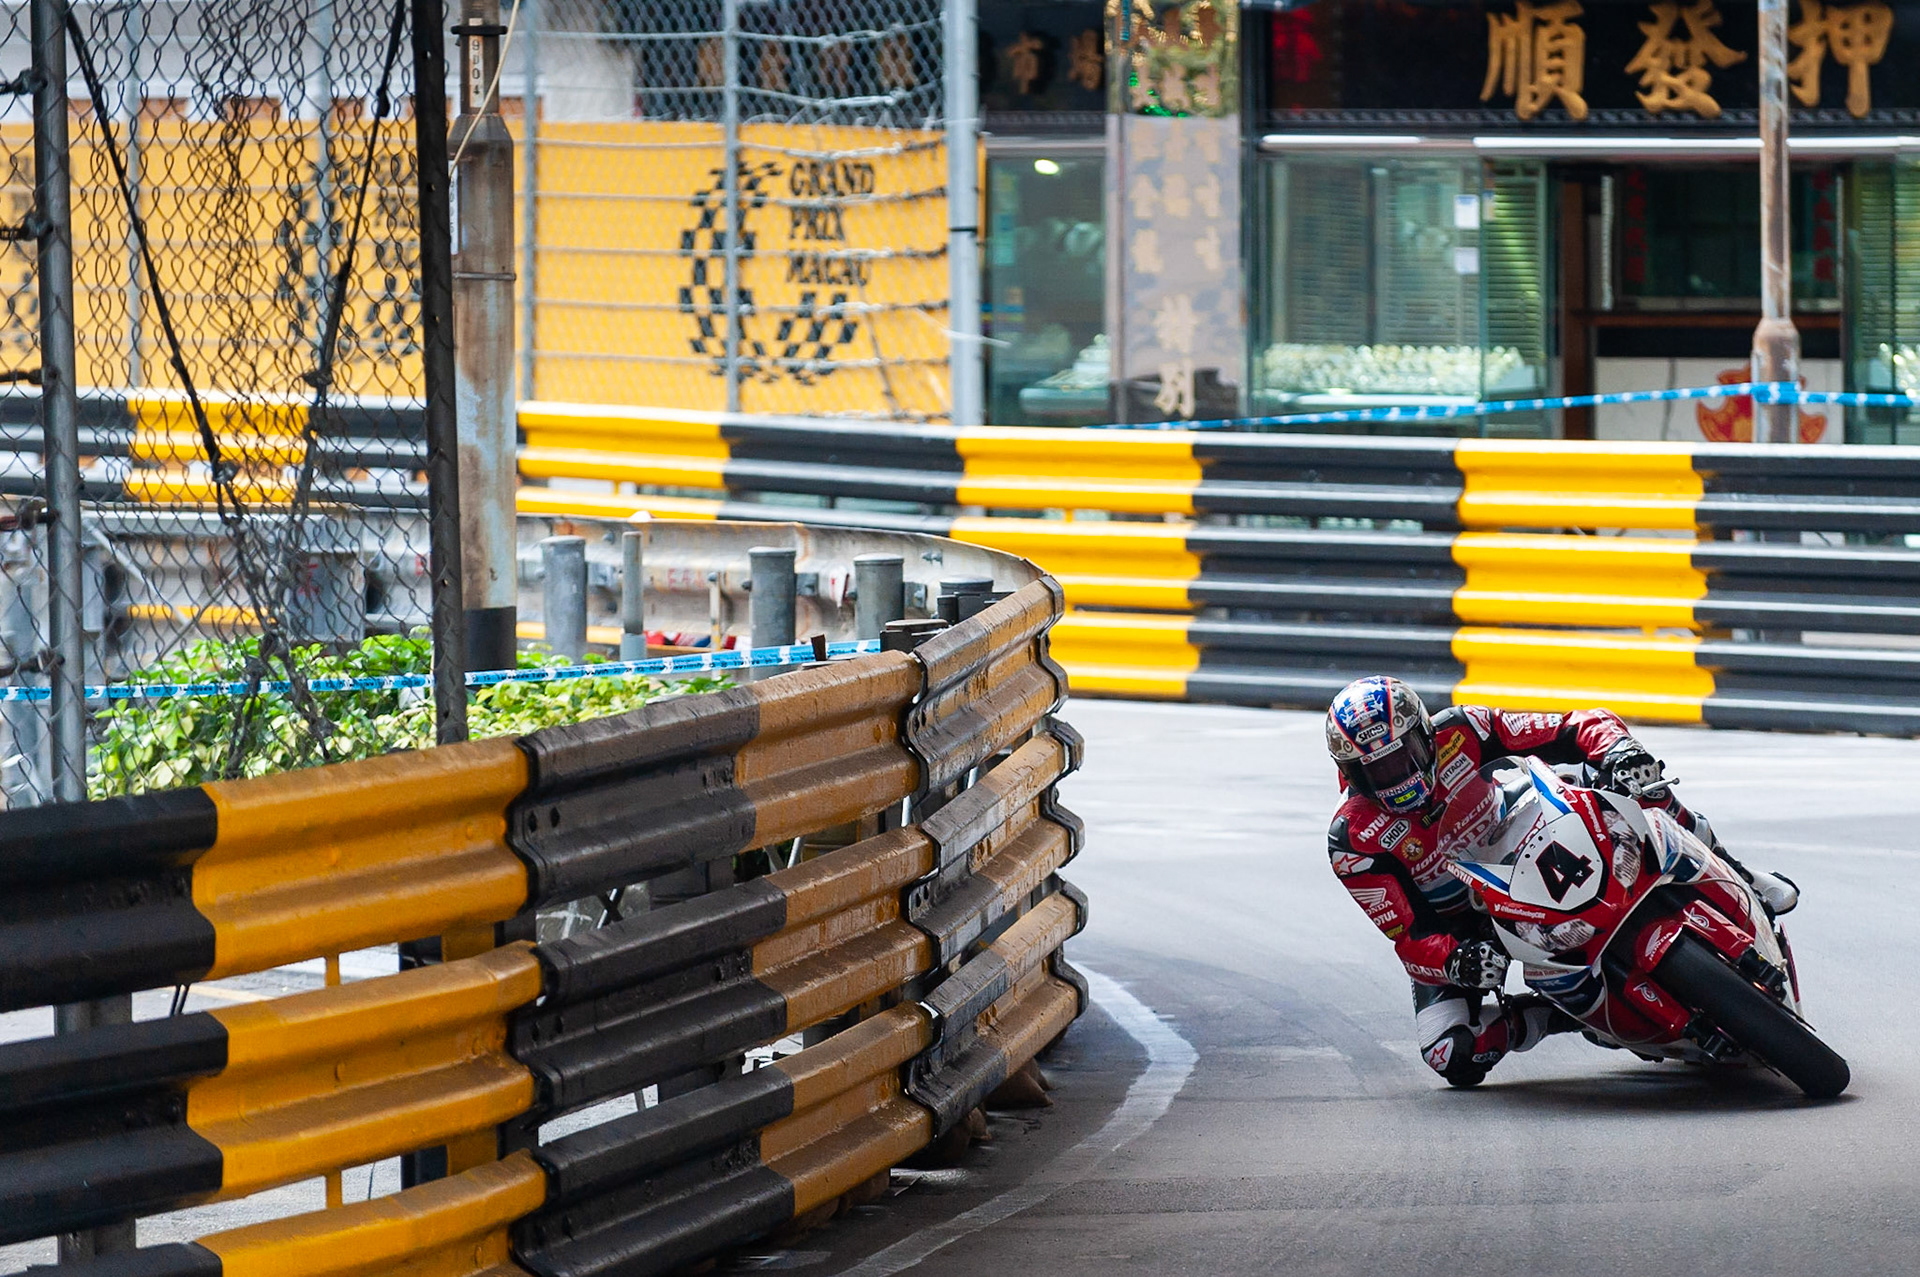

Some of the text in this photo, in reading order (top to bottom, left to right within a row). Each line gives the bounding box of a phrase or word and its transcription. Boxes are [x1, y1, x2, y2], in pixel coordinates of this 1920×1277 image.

[1372, 741, 1400, 759] bennetts
[1357, 813, 1390, 843] MOTUL
[1382, 820, 1407, 848] SHOEI
[1446, 863, 1474, 887] MOTUL
[1535, 840, 1595, 905] 4
[1365, 900, 1394, 916] ONDA
[1373, 909, 1398, 926] OTUL
